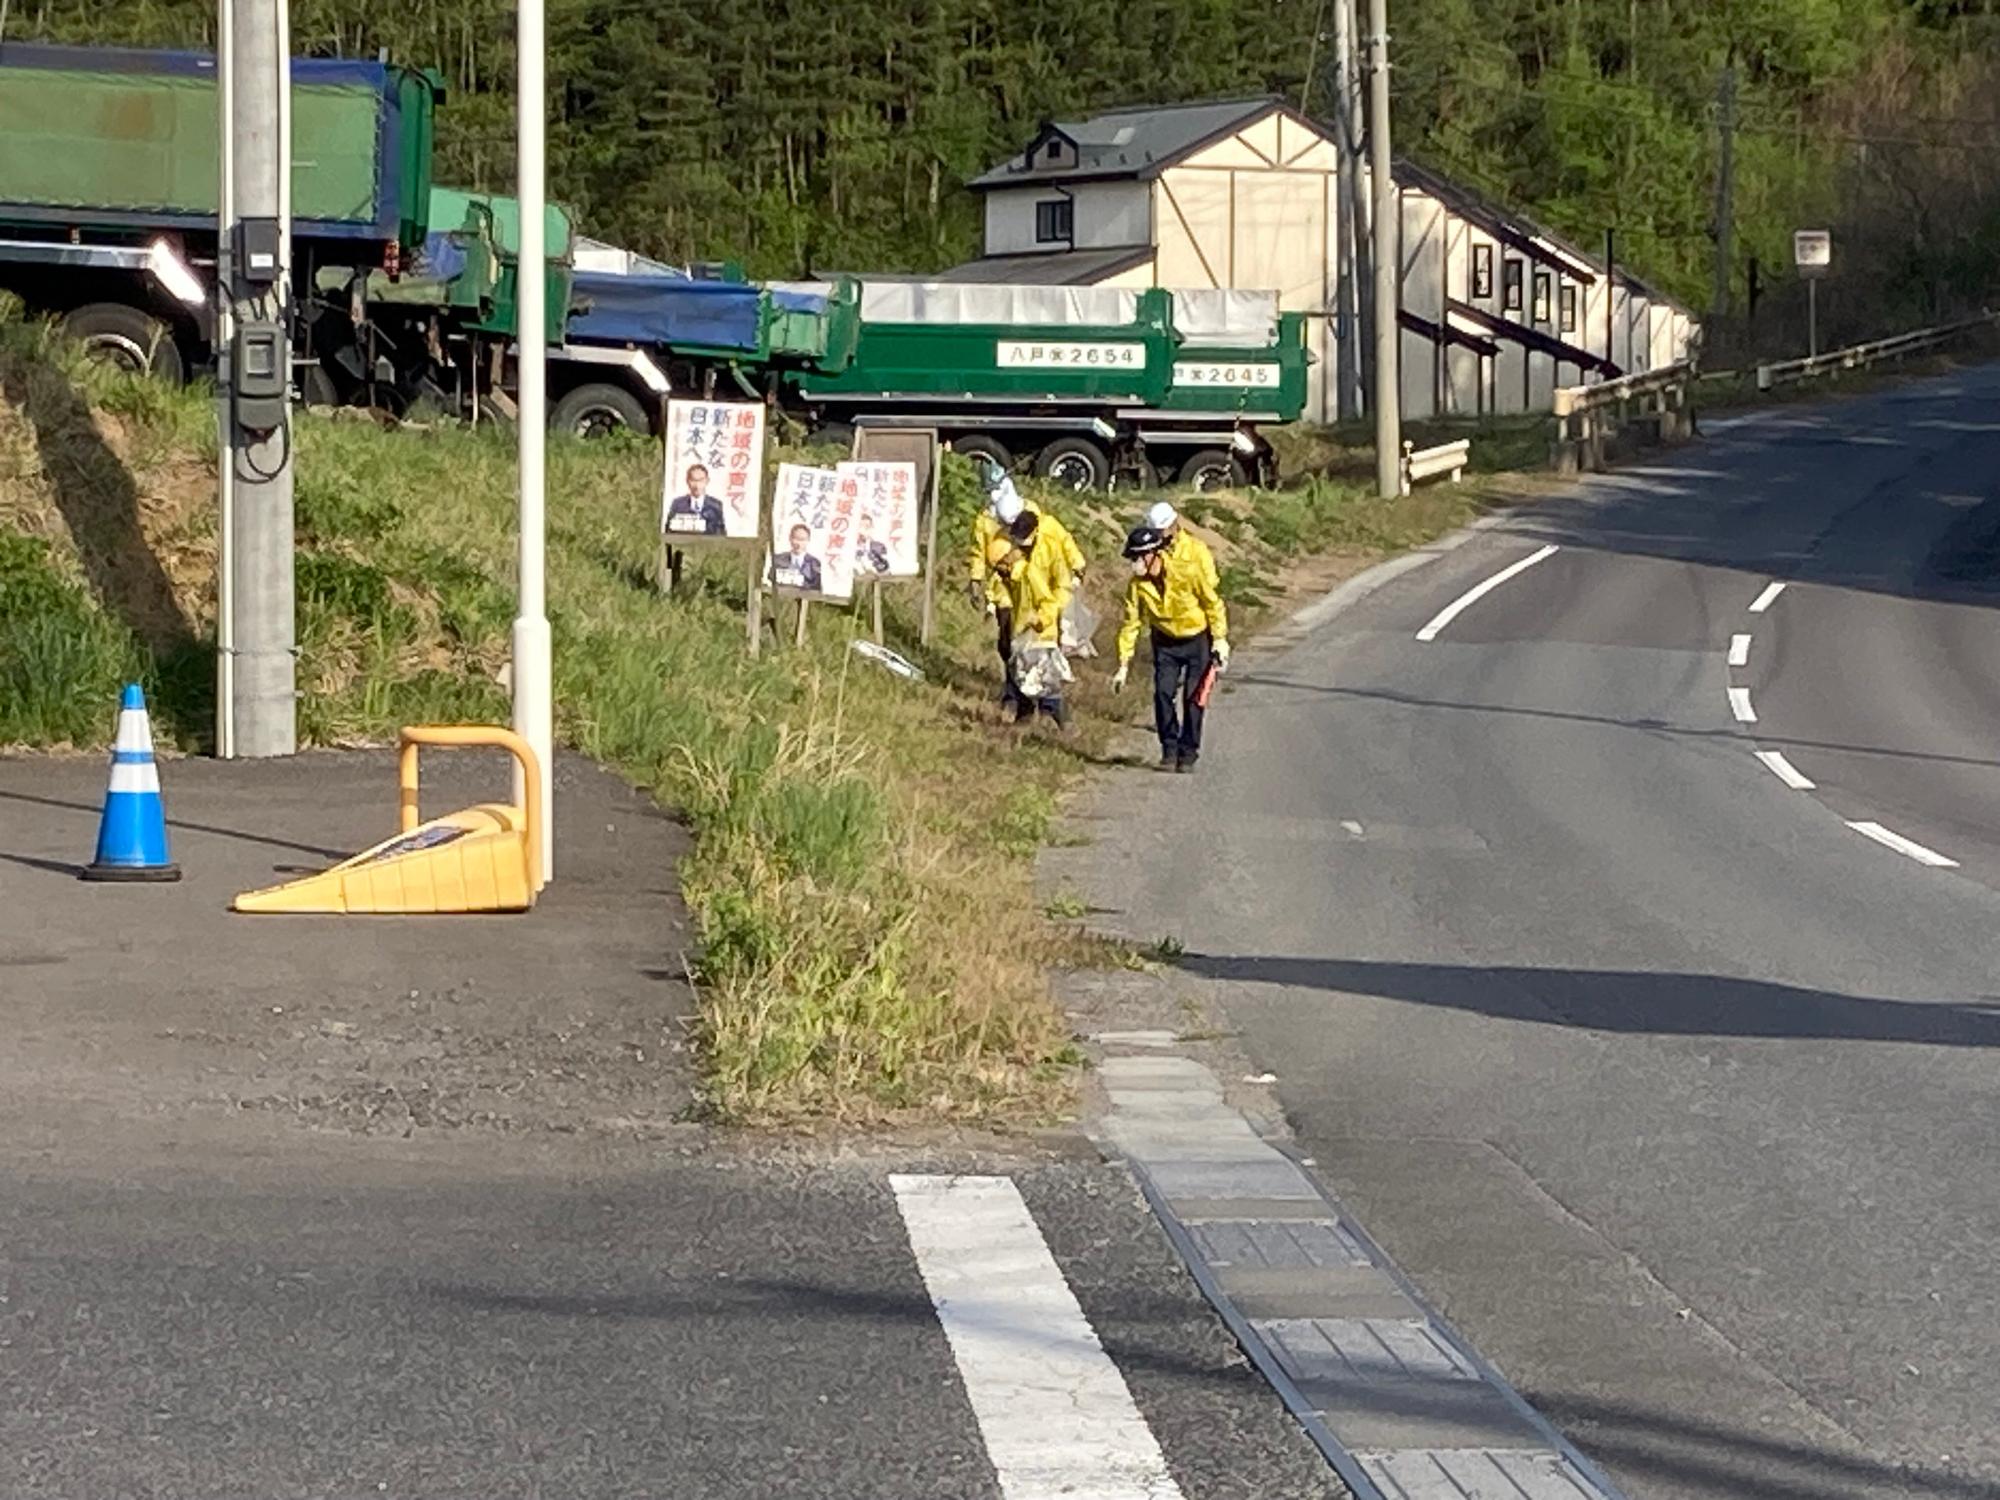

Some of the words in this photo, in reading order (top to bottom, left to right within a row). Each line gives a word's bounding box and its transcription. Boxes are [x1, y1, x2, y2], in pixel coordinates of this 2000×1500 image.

[682, 407, 708, 461] 日本へ
[708, 408, 732, 469] 新たな
[789, 471, 815, 522] 日本へ
[810, 475, 837, 529] 新たな
